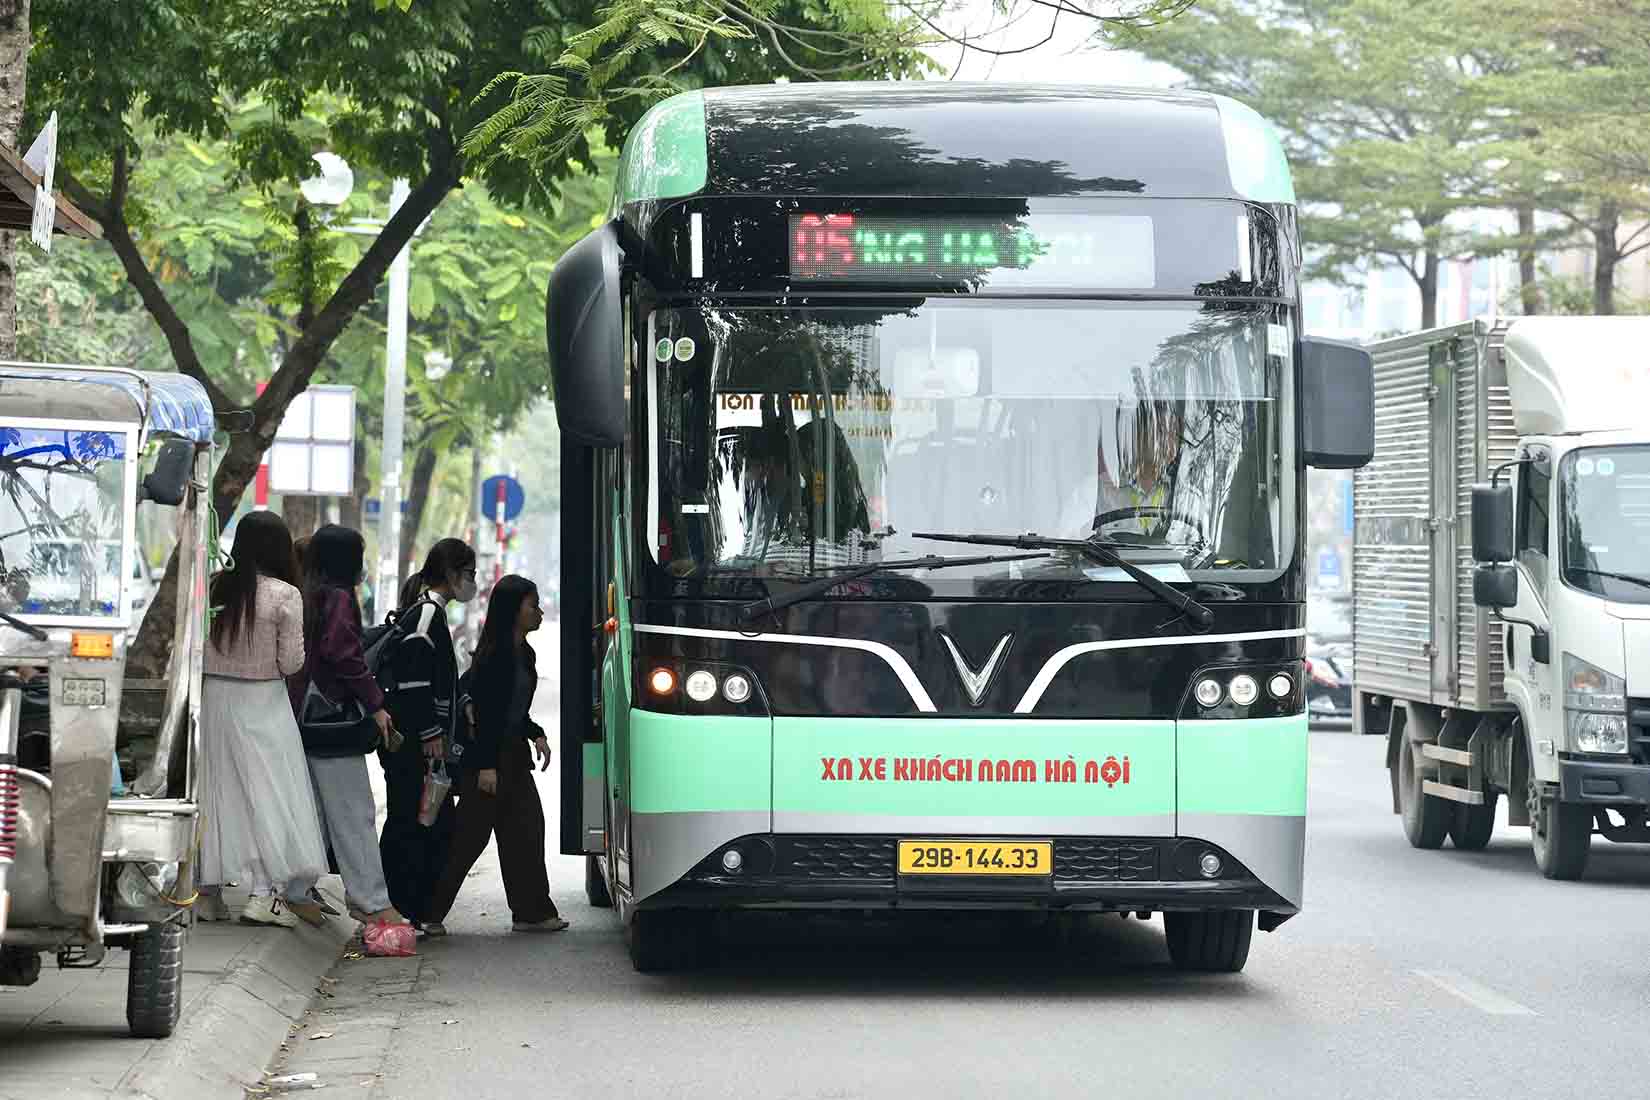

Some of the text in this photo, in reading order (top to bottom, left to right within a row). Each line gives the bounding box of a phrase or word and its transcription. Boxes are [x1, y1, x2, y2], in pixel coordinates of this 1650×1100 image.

[797, 213, 854, 276] 05
[821, 754, 1130, 789] XN XE KHÁCH NAM HÀ NỘI
[911, 847, 1039, 868] 29B-144.33
